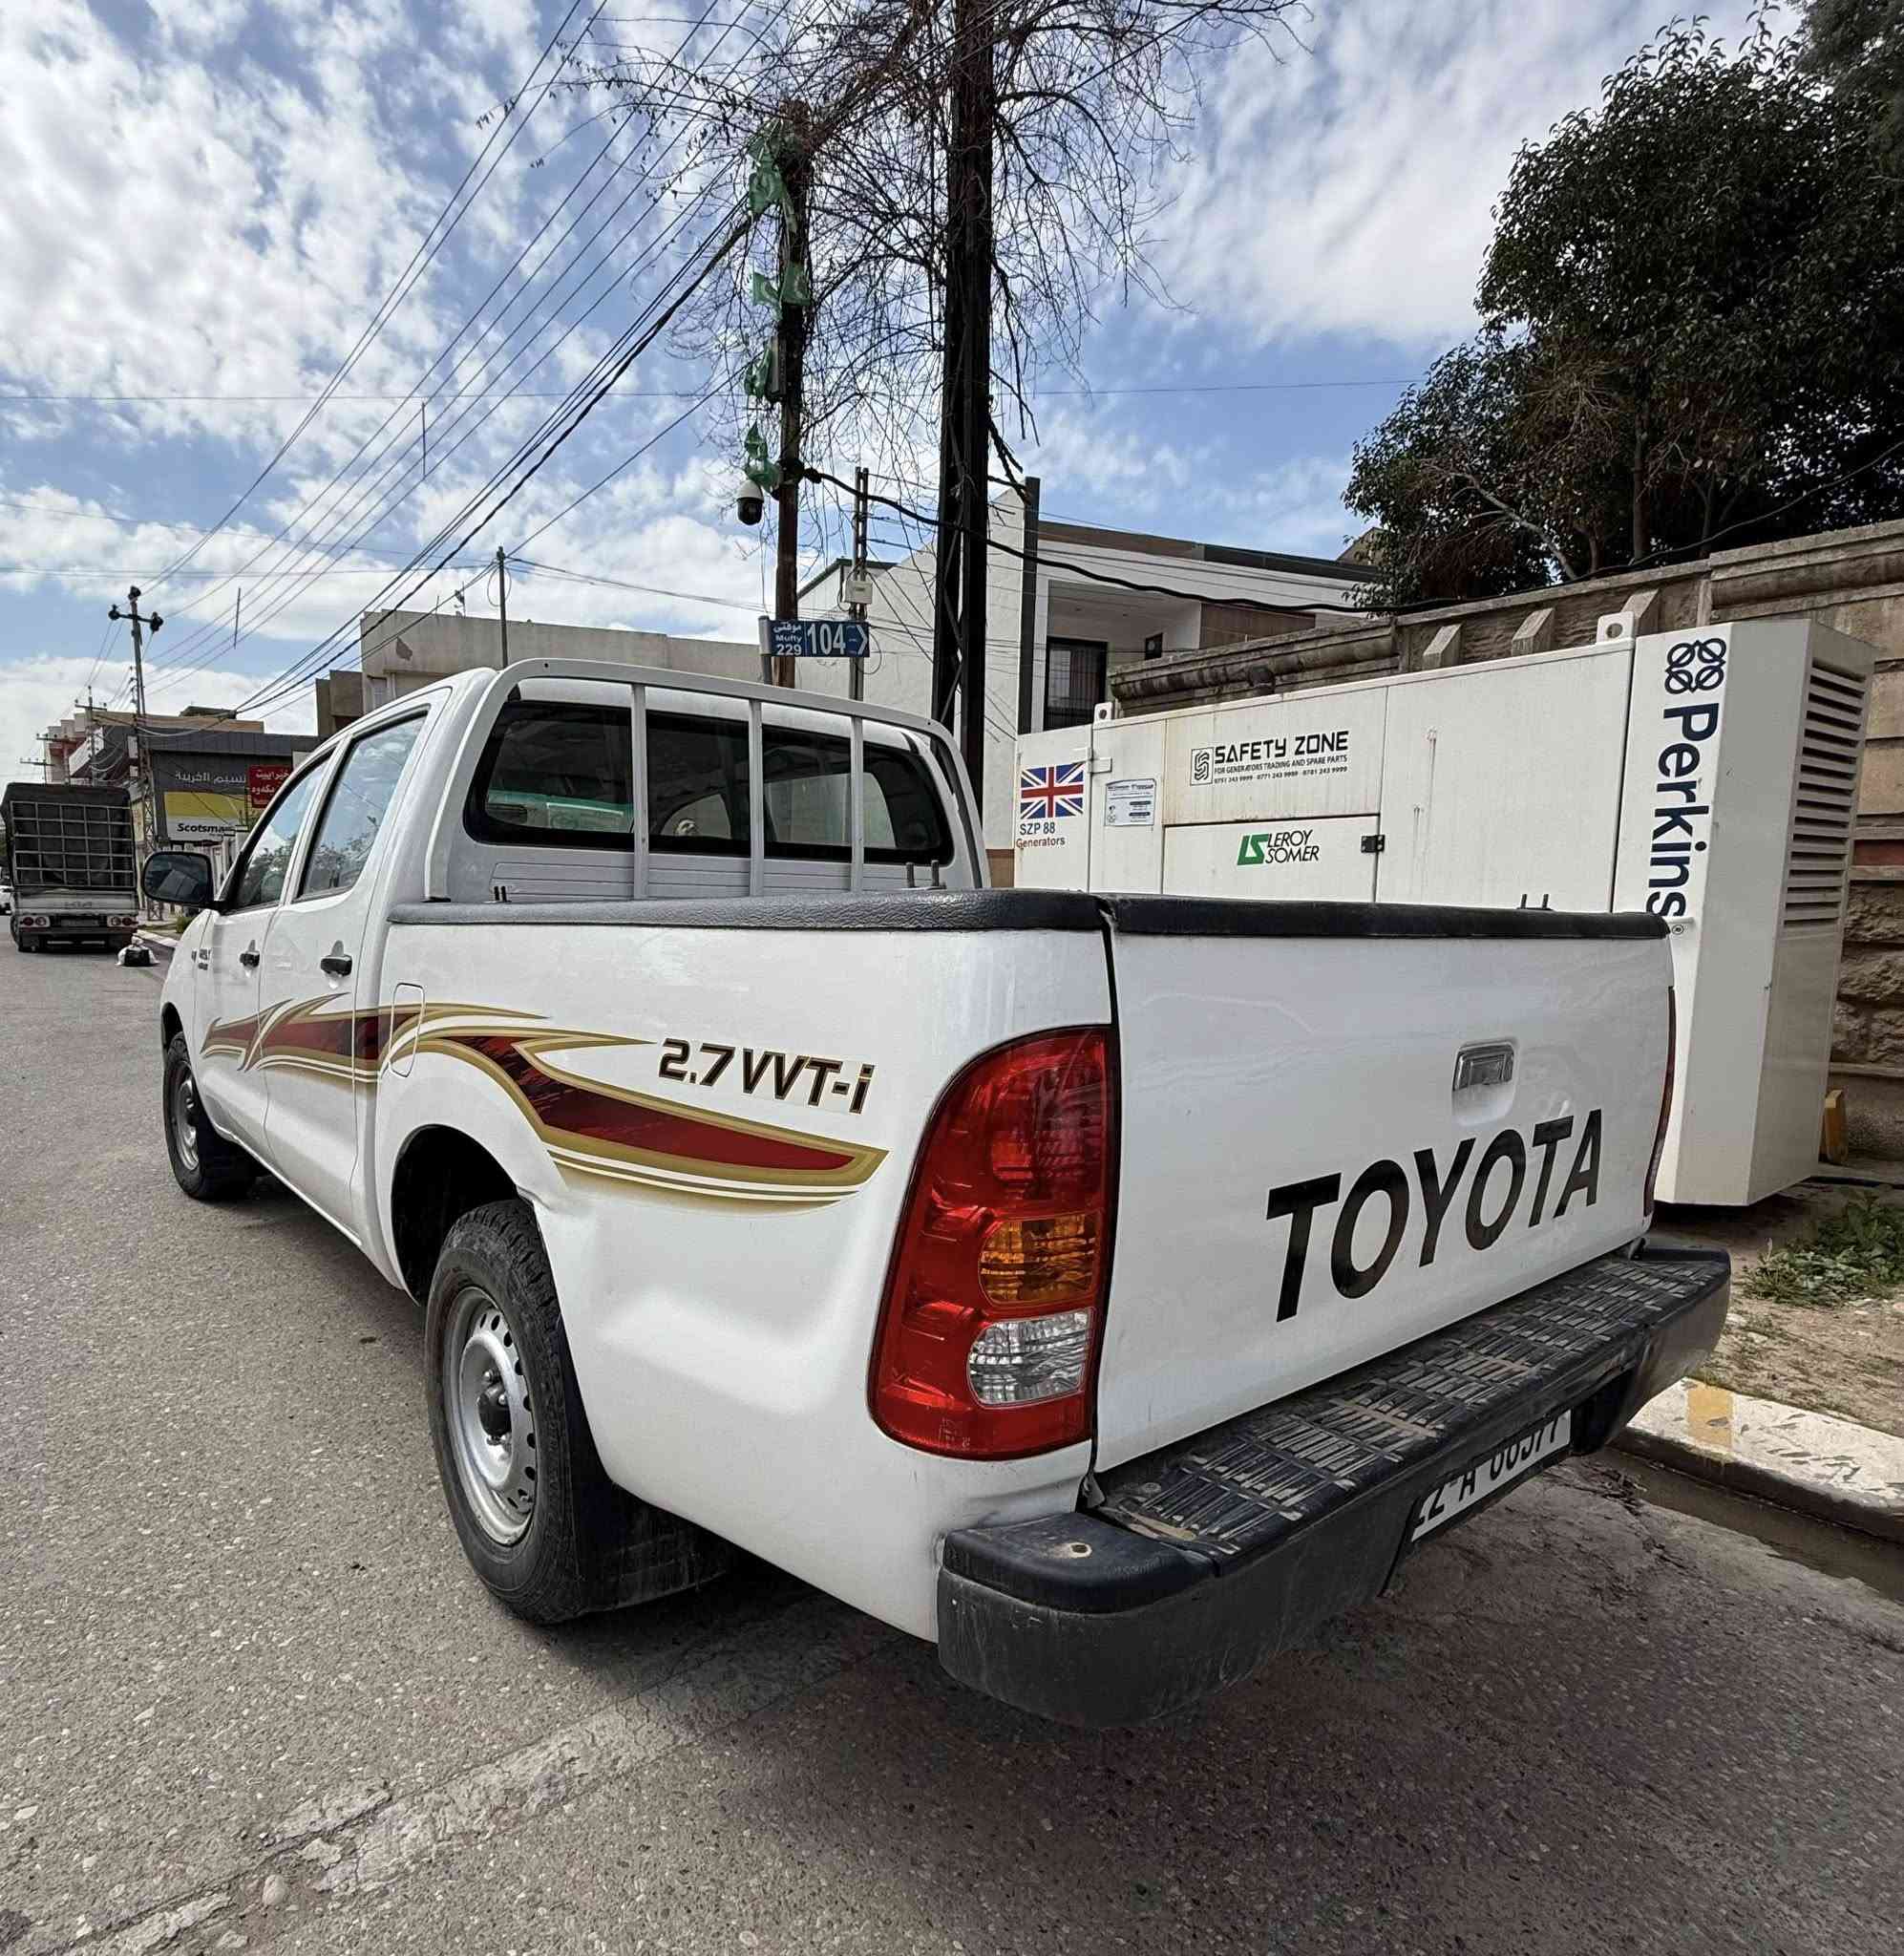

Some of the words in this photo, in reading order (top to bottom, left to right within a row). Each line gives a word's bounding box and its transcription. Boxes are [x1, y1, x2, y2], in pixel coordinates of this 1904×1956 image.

[807, 623, 846, 655] 104
[776, 645, 802, 656] 229
[1215, 738, 1287, 764] SAFETY
[1294, 731, 1349, 755] ZONE
[1226, 763, 1262, 774] GENERATORS
[1264, 761, 1290, 771] TRADING
[1292, 759, 1306, 768] AND
[1306, 756, 1325, 766] SPARE
[1326, 755, 1347, 764] PARTS
[1645, 702, 1720, 917] Perkins
[1019, 822, 1041, 836] SZP
[1043, 821, 1055, 835] 88
[1016, 837, 1066, 849] Generators
[1267, 829, 1313, 848] LEROY
[1265, 845, 1320, 864] SOMER
[659, 1037, 736, 1087] 2.7
[743, 1047, 876, 1115] VVT-i
[1266, 1108, 1602, 1323] TOYOTA
